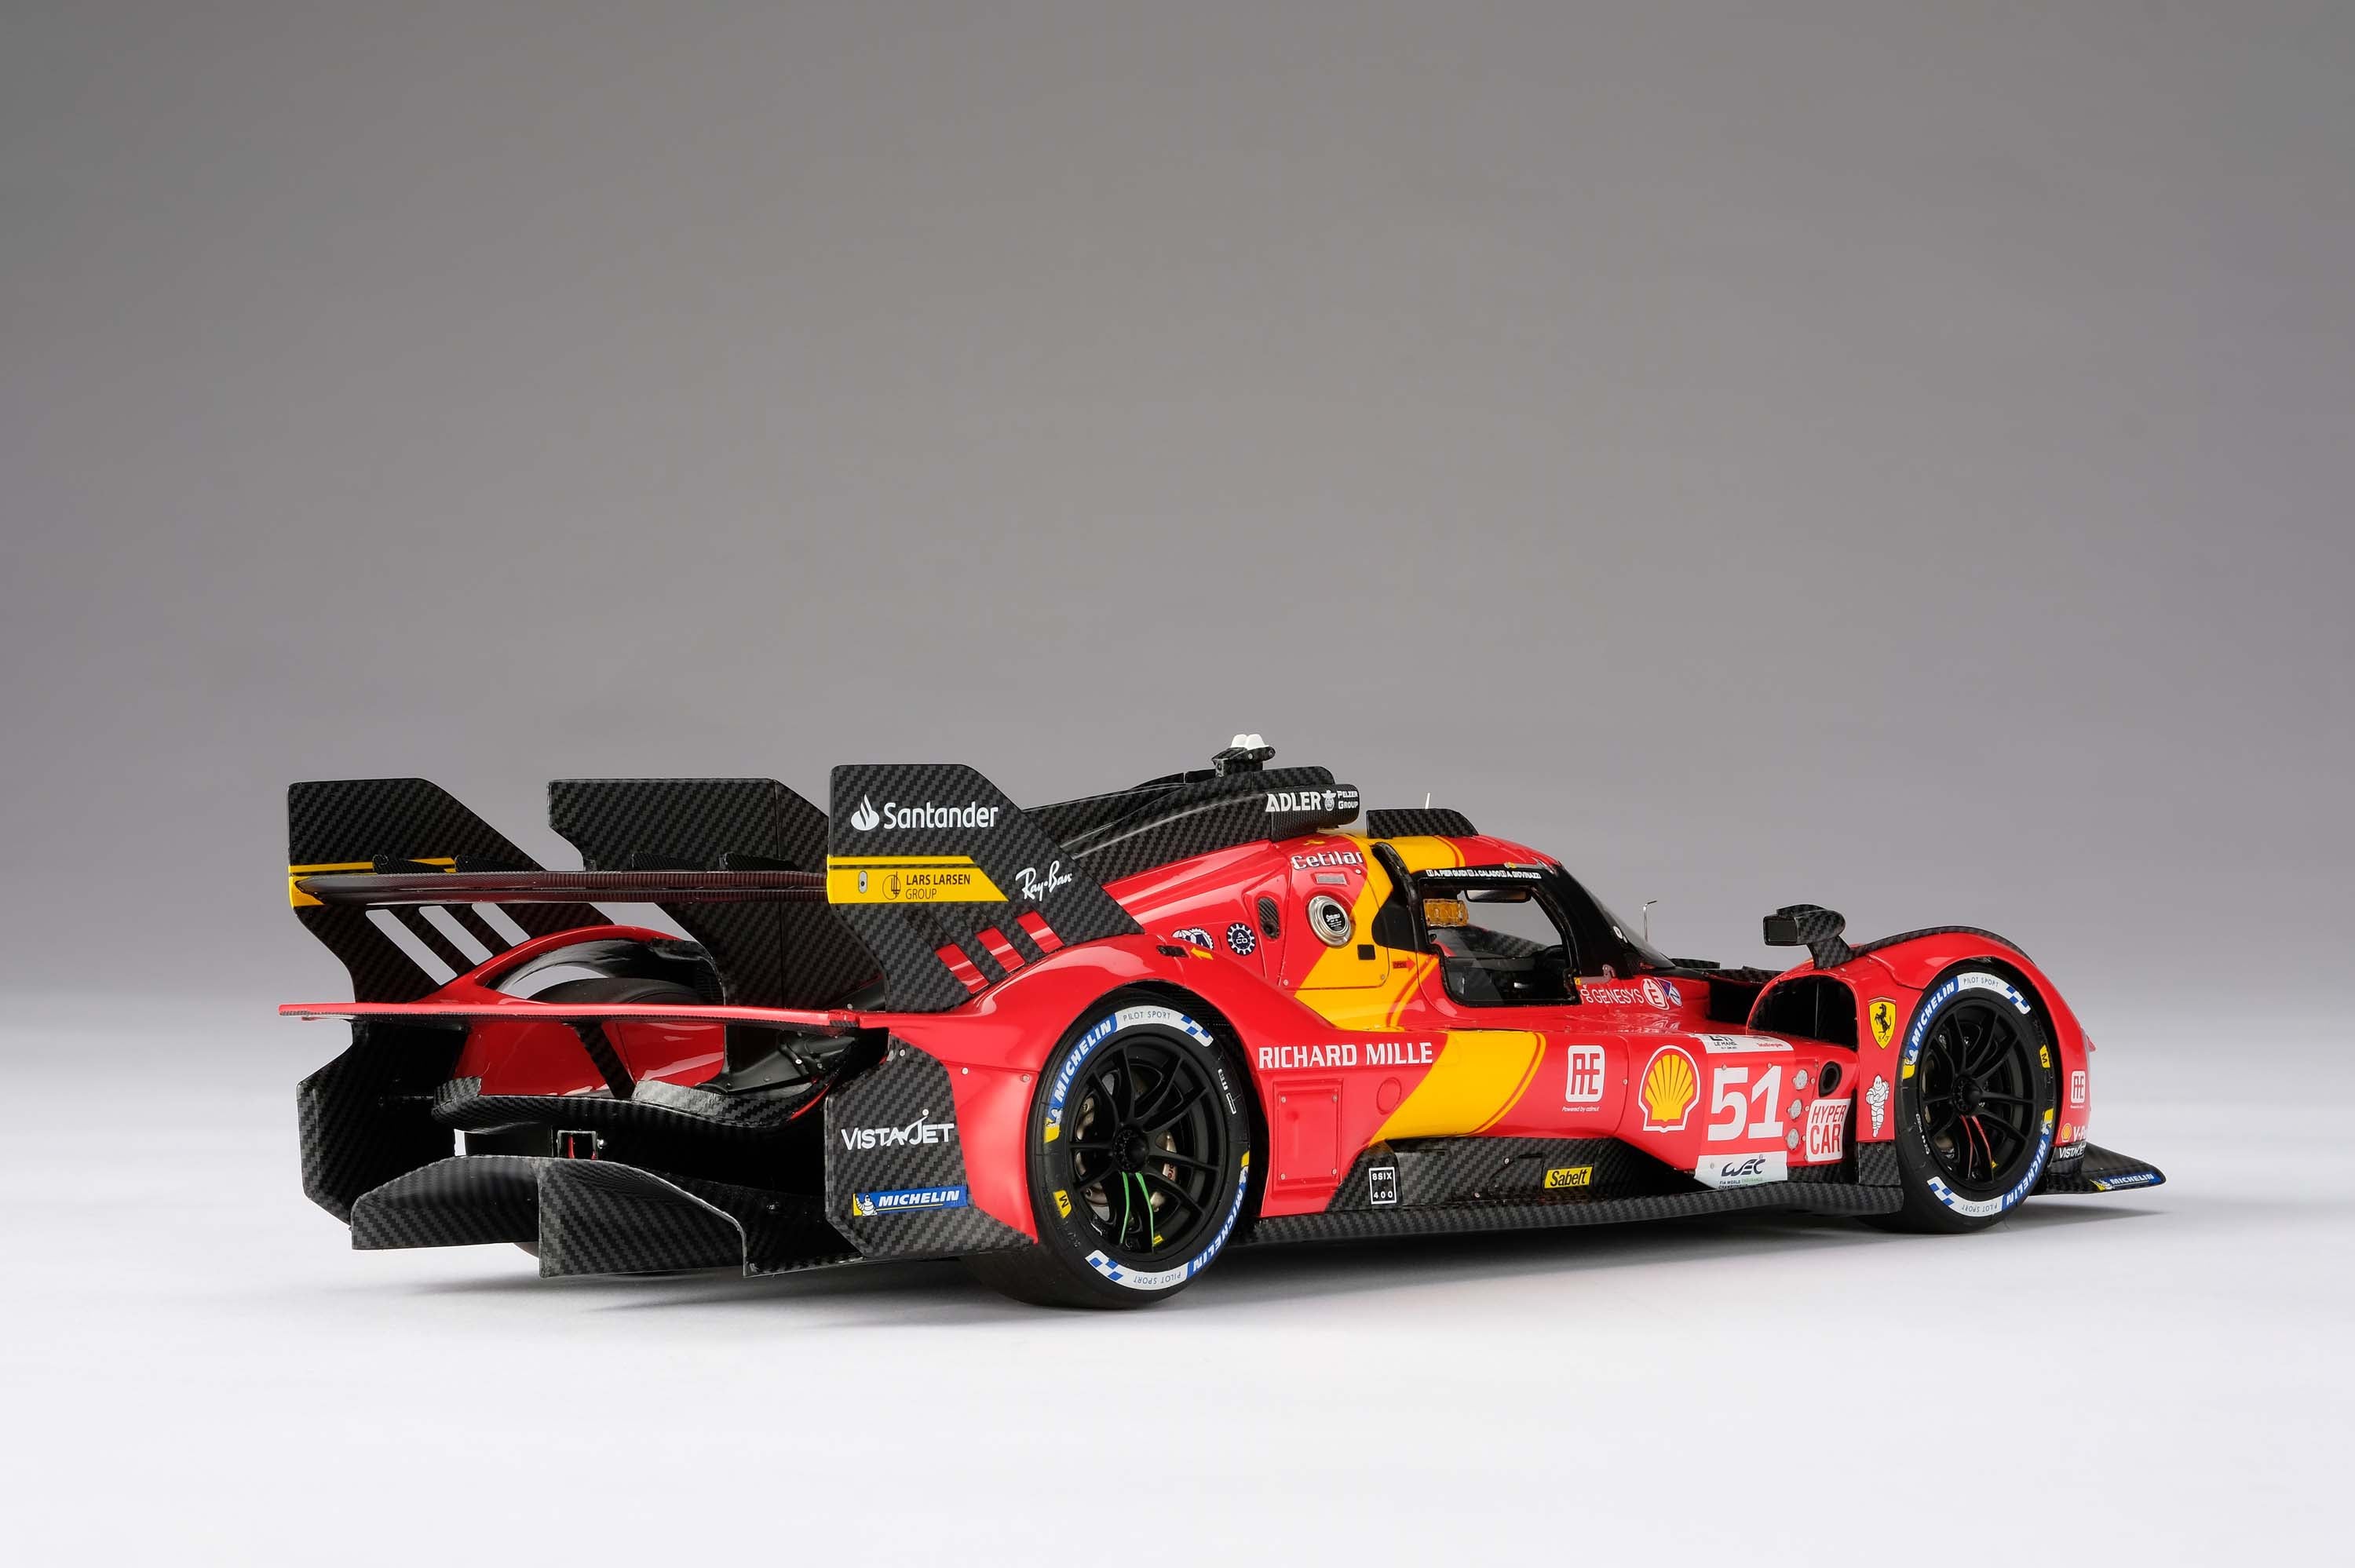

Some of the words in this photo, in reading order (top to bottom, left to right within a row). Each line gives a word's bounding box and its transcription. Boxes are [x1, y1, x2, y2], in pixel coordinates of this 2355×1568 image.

[1265, 793, 1321, 811] ADLER
[1338, 800, 1358, 809] GROUP
[883, 801, 999, 830] Santander
[1291, 851, 1363, 870] Cetilar
[906, 874, 930, 886] LARS
[933, 873, 970, 885] LARSEN
[906, 888, 937, 900] GROUP
[1962, 976, 1978, 985] PILOT
[1981, 977, 1999, 987] SPORT
[1592, 989, 1645, 1004] GENESYS
[1123, 1011, 1144, 1022] PILOT
[1148, 1012, 1170, 1020] SPORT
[1912, 981, 1955, 1047] MICHELIN
[1054, 1019, 1113, 1104] MICHELIN
[1258, 1045, 1357, 1068] RICHARD
[1366, 1042, 1433, 1065] MILLE
[1707, 1066, 1784, 1141] 51
[1812, 1104, 1846, 1123] HYPER
[842, 1116, 955, 1150] VISTAJET
[1809, 1124, 1841, 1154] CAR
[1722, 1159, 1766, 1176] WEC
[2006, 1140, 2046, 1205] MICHELIN
[1550, 1169, 1586, 1187] Sabelt
[2110, 1173, 2154, 1184] MICHELIN
[878, 1191, 959, 1207] MICHELIN
[1374, 1191, 1393, 1199] 400
[1961, 1205, 1980, 1213] SPORT
[1193, 1189, 1243, 1272] MICHELIN
[1133, 1275, 1158, 1285] SPORT
[1160, 1271, 1181, 1283] PILOT
